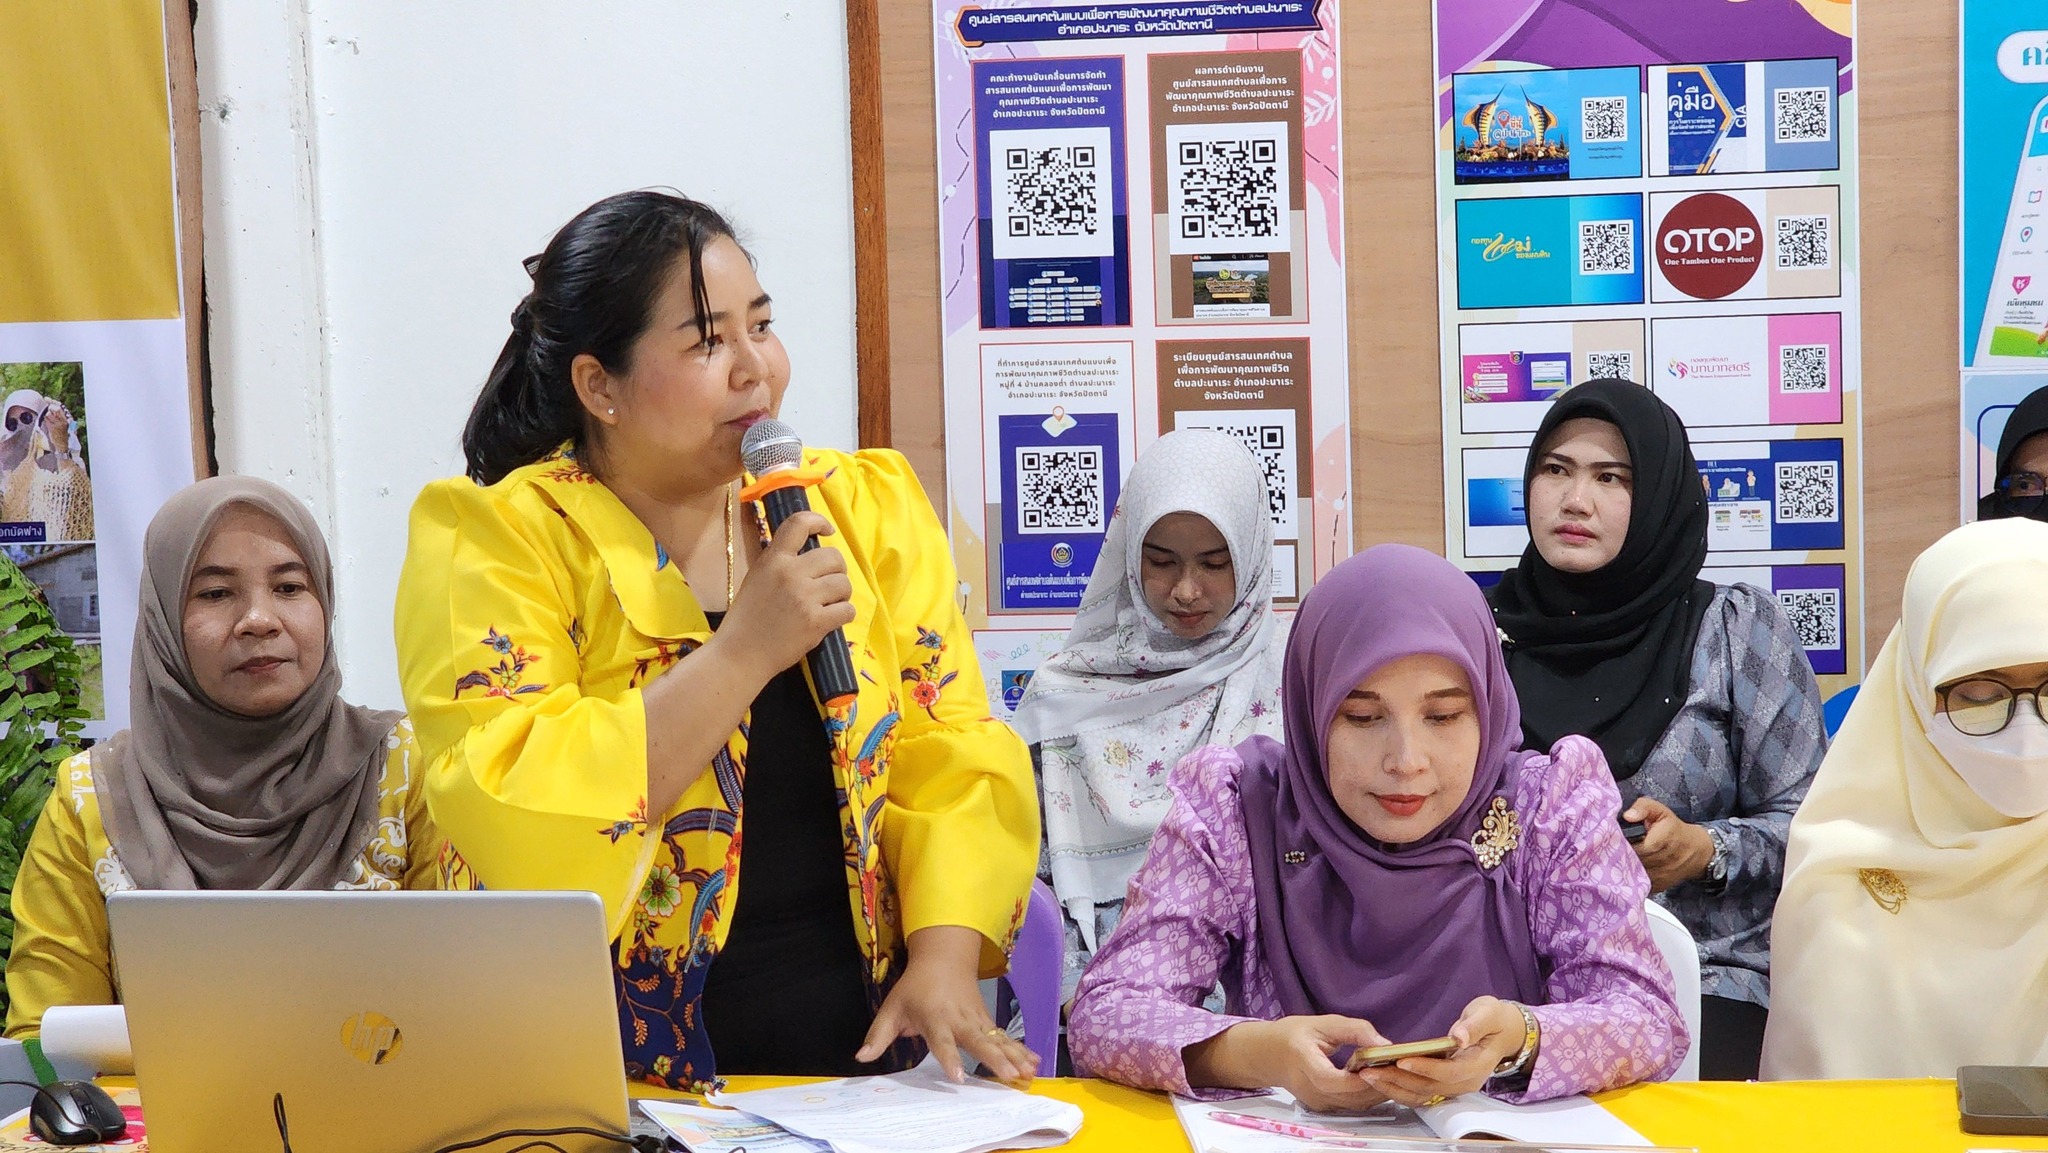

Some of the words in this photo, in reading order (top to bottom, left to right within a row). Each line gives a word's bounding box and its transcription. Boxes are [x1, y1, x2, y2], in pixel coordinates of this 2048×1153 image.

[1058, 23, 1130, 35] อำเภอปะนาเระ
[1134, 18, 1213, 33] จังหวัดปัตตานี
[990, 70, 1107, 83] คณะทำงานขับเคลื่อนการจัดทำ
[1195, 65, 1264, 75] ผลการดำเนินงาน
[985, 82, 1112, 95] สารสนเทศต้นแบบเพื่อการพัฒนา
[1173, 74, 1287, 90] ศูนย์สารสนเทศตำบลเพื่อการ
[999, 95, 1099, 108] คุณภาพชีวิตตำบลปะนาเระ
[1166, 88, 1295, 102] พัฒนาคุณภาพชีวิตตำบลปะนาเระ
[1668, 81, 1716, 118] คู่มือ
[993, 108, 1048, 118] อำเภอปะนาเระ
[1050, 106, 1105, 116] จังหวัดปัตตานี
[1172, 103, 1229, 113] อำเภอปะนาเระ
[1232, 100, 1288, 111] จังหวัดปัตตานี
[1735, 104, 1747, 128] CIA
[1663, 227, 1755, 254] OTOP
[1664, 258, 1680, 266] One
[1681, 257, 1710, 265] Tambon
[1711, 256, 1726, 264] One
[1727, 255, 1755, 264] Product
[997, 356, 1117, 369] ที่ทำการศูนย์สารสนเทศต้นแบบเพื่อ
[1173, 351, 1293, 363] ระเบียบศูนย์สารสนเทศตำบล
[995, 368, 1119, 379] การพัฒนาคุณภาพชีวิตตำบลปะนาเระ
[1177, 363, 1289, 376] เพื่อการพัฒนาคุณภาพชีวิต
[1690, 362, 1750, 373] บทบาทสตรี
[999, 380, 1015, 390] หมู่ที่
[1069, 378, 1116, 387] ตำบลปะนาเระ
[1174, 379, 1231, 388] ตำบลปะนาเระ
[1233, 377, 1294, 387] อำเภอปะนาเระ
[1007, 390, 1057, 399] อำเภอปะนาเระ
[1059, 389, 1108, 398] จังหวัดปัตตานี
[1204, 389, 1264, 400] จังหวัดปัตตานี
[351, 1010, 399, 1065] hp
